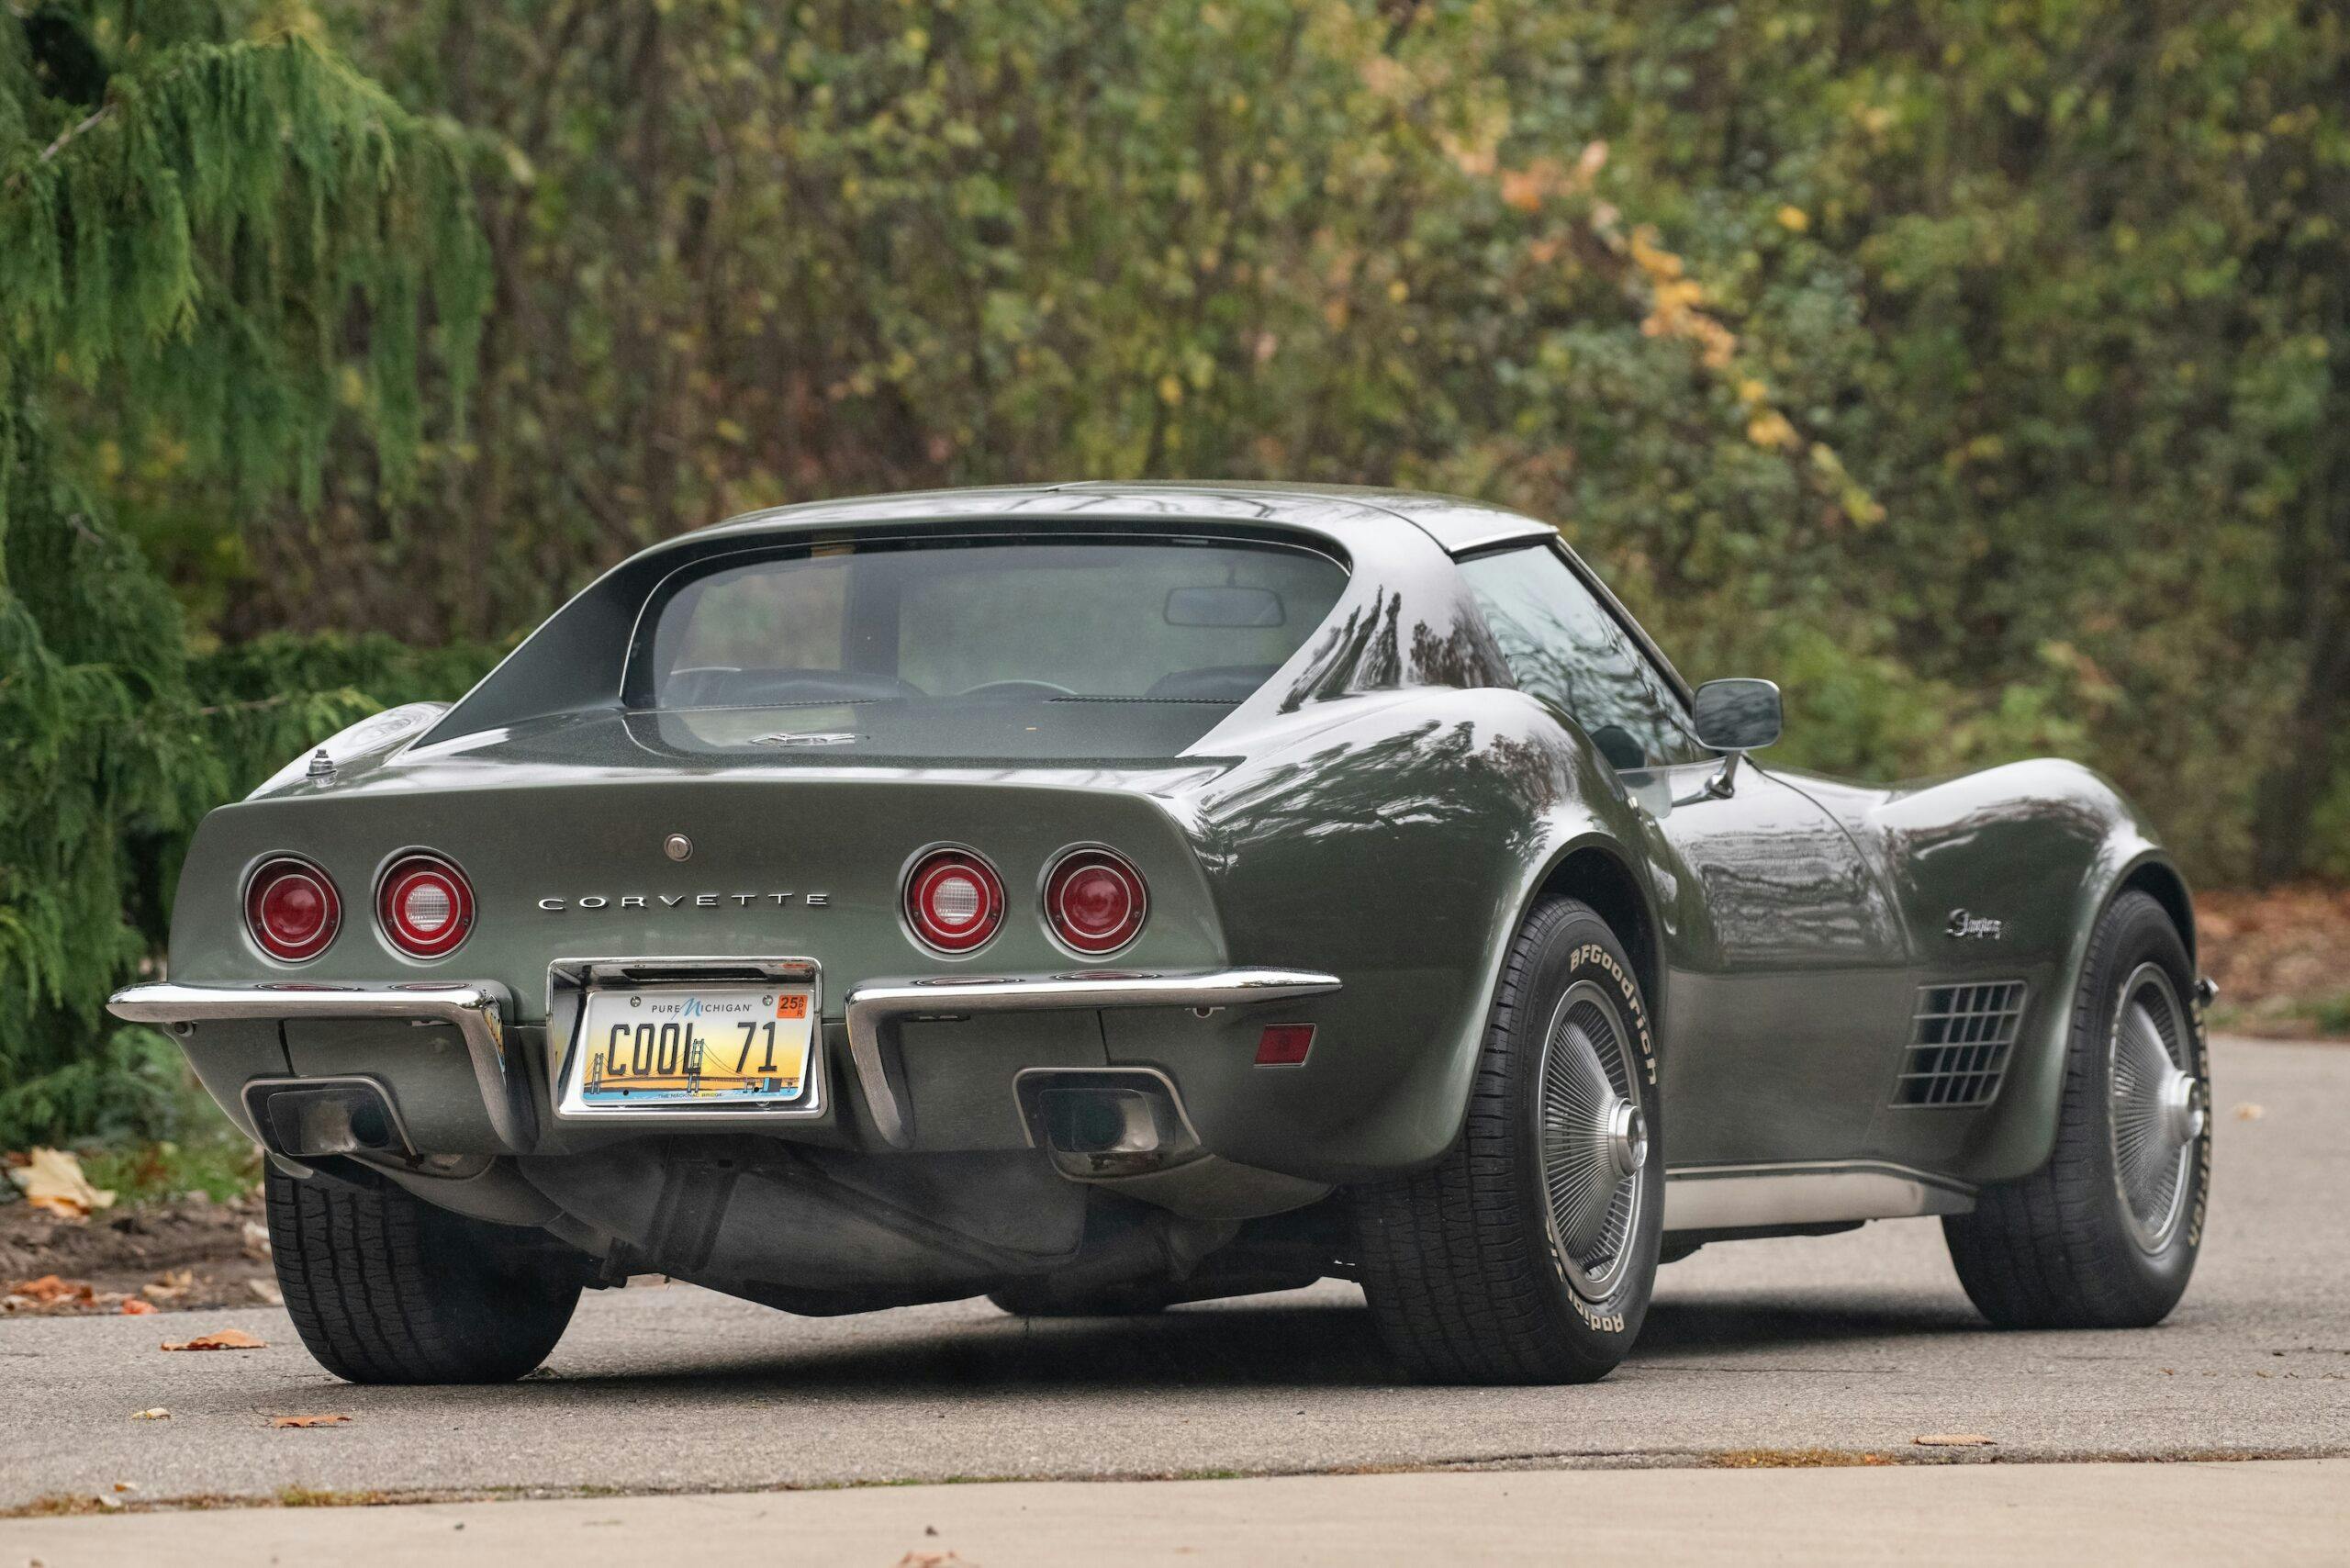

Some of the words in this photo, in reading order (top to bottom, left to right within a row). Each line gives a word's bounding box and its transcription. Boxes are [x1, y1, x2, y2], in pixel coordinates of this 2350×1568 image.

[539, 894, 829, 910] CORVETTE
[651, 1004, 680, 1014] PURE
[672, 998, 752, 1020] MICHIGAN
[780, 996, 798, 1009] 25
[1570, 944, 1657, 1085] BFGoodrich
[608, 1023, 702, 1076] COOL
[737, 1021, 778, 1073] 71
